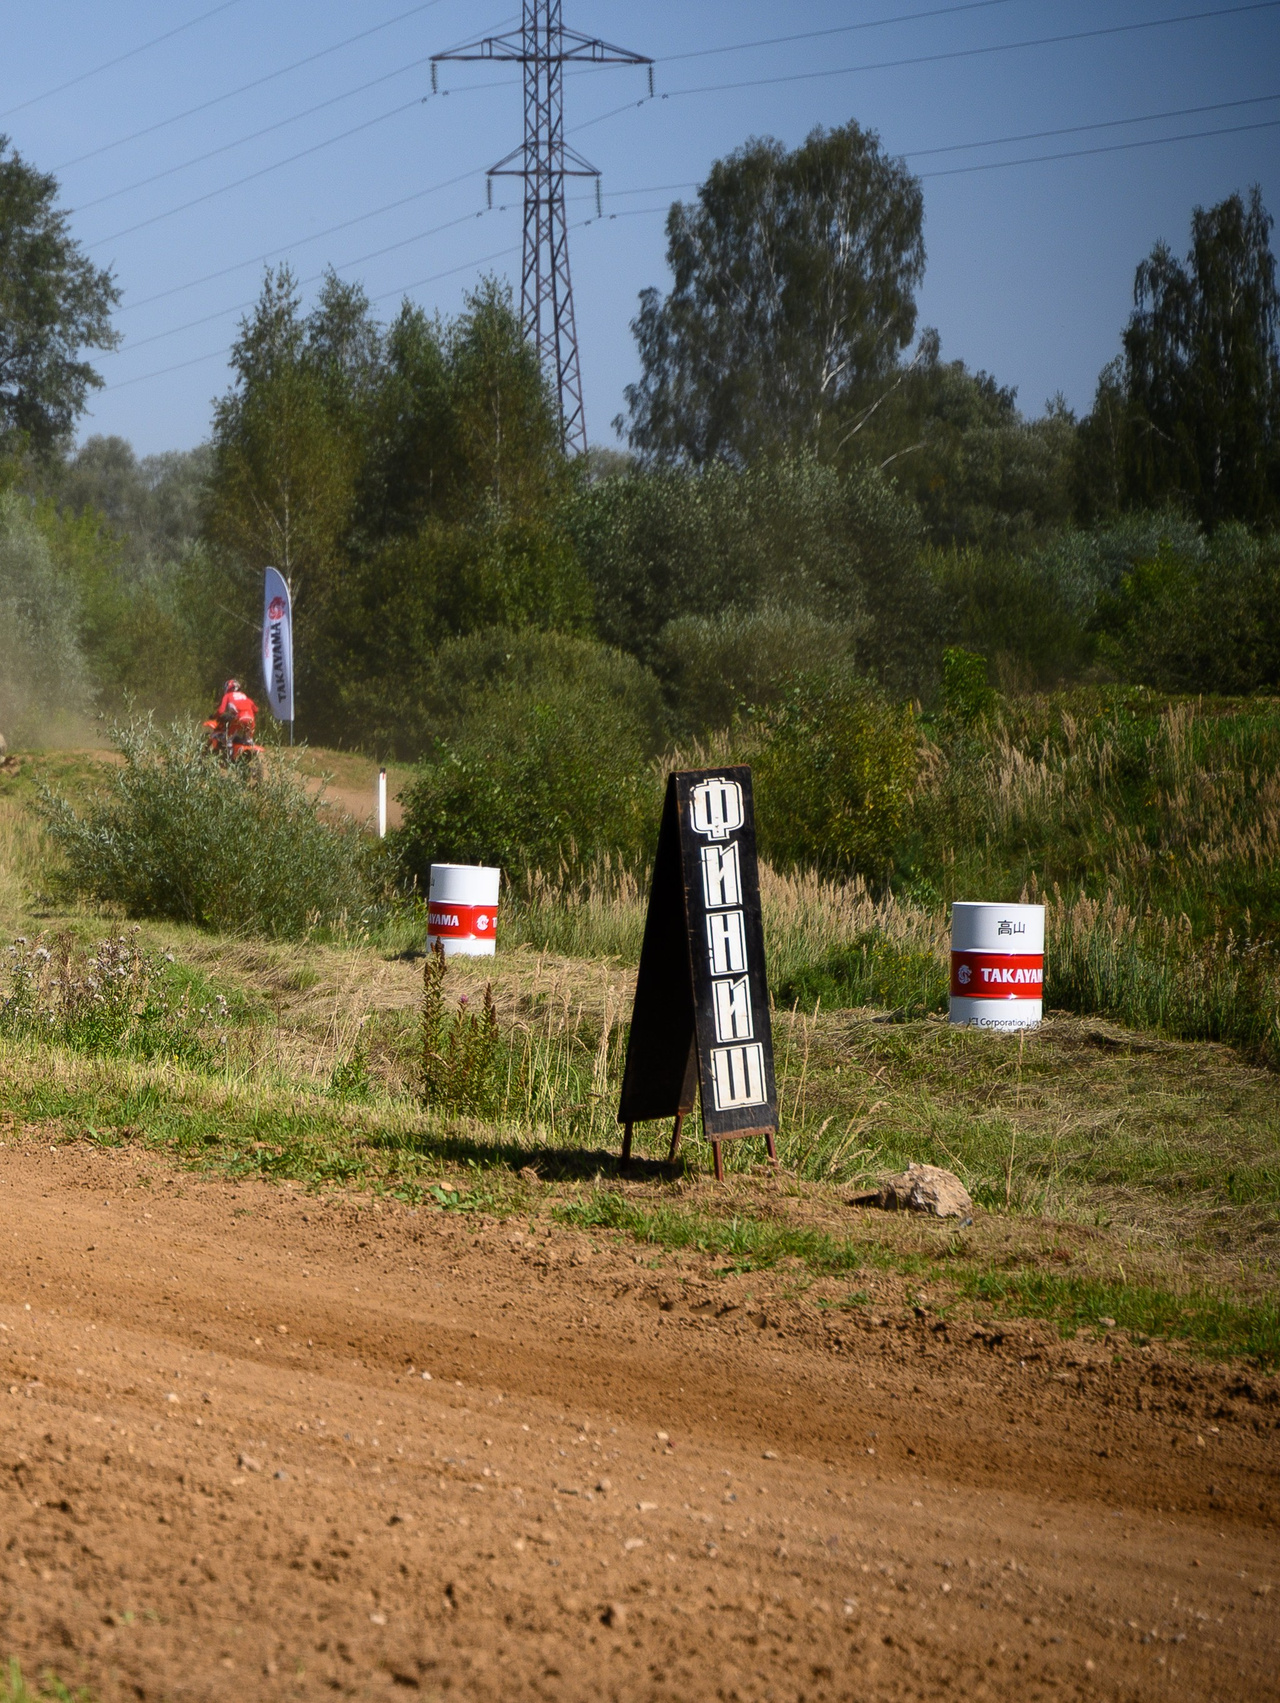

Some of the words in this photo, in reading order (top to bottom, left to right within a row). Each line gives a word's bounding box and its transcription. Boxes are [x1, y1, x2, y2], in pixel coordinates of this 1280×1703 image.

[270, 622, 287, 704] TAKAYAMA
[690, 777, 768, 1112] ФИНИШ
[997, 919, 1025, 935] 高山
[980, 1017, 1026, 1027] Corporation
